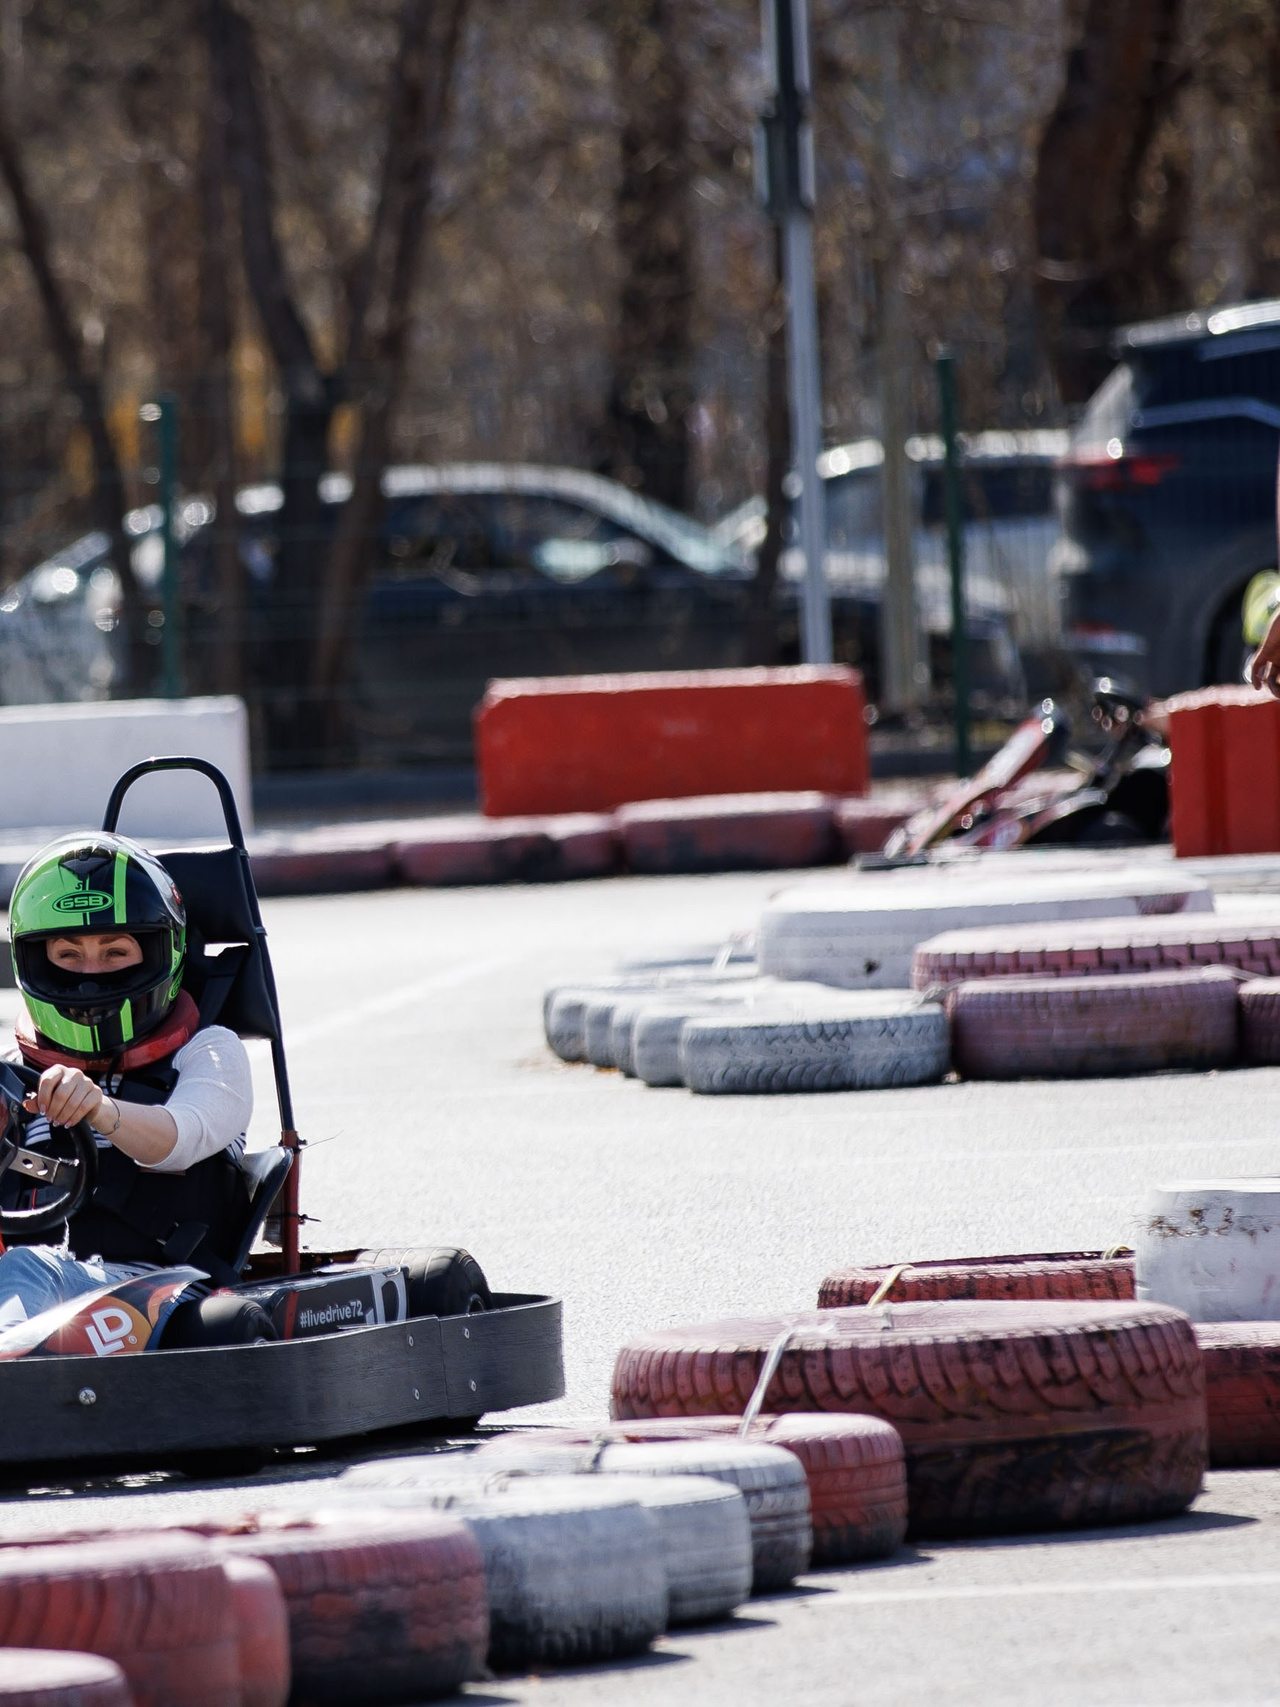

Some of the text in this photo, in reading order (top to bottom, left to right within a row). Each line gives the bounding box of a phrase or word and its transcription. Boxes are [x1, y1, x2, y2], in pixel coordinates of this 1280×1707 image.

[60, 895, 104, 909] GSB
[300, 1300, 364, 1328] #livedrive72
[85, 1308, 133, 1357] LD
